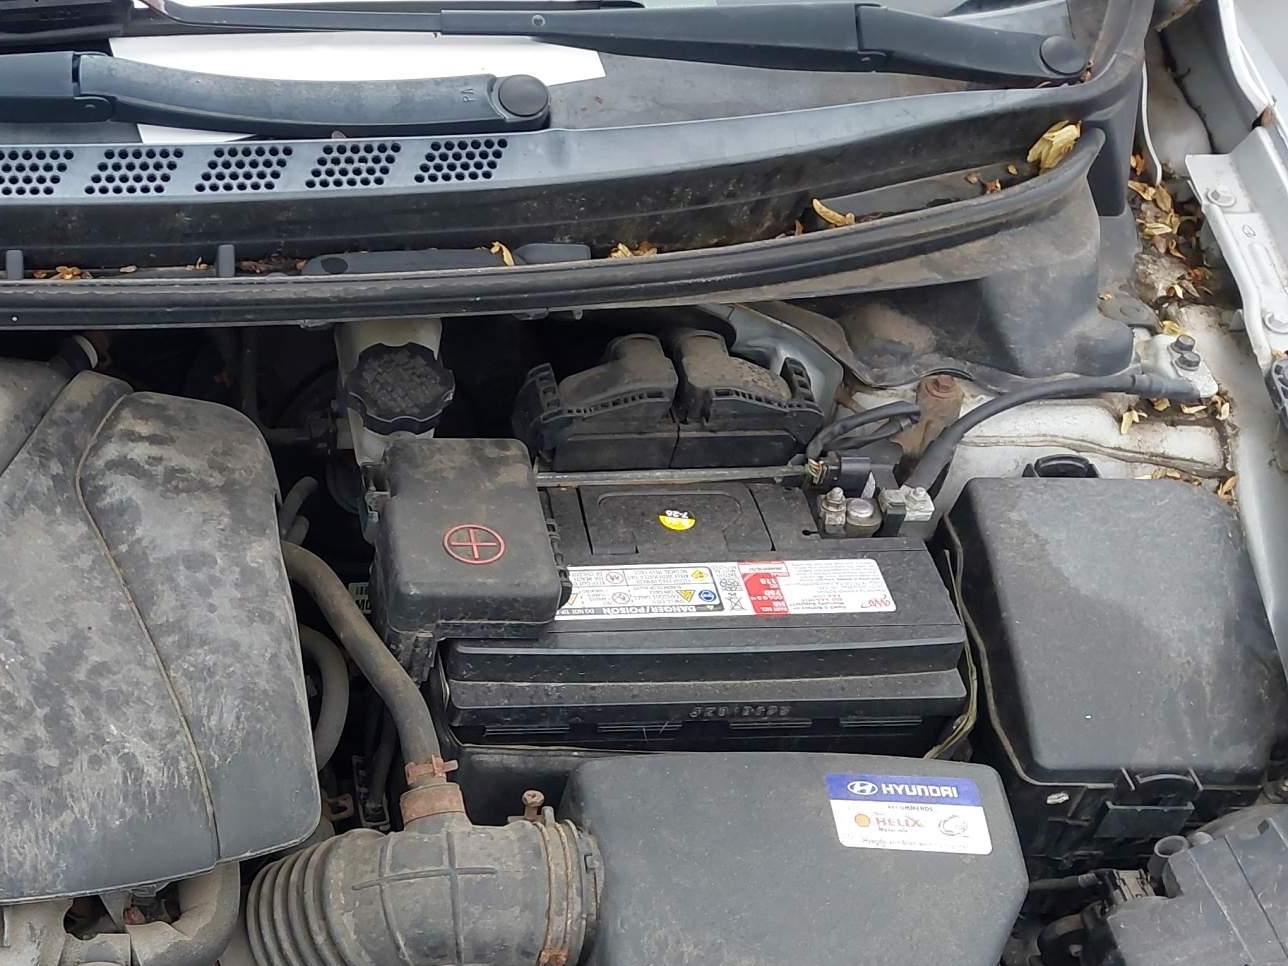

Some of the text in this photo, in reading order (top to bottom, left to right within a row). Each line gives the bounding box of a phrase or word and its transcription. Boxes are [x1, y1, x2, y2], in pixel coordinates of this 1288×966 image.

[601, 605, 698, 615] DANGER/POISON
[881, 783, 960, 798] HYUNDAI
[875, 816, 924, 828] HELIX
